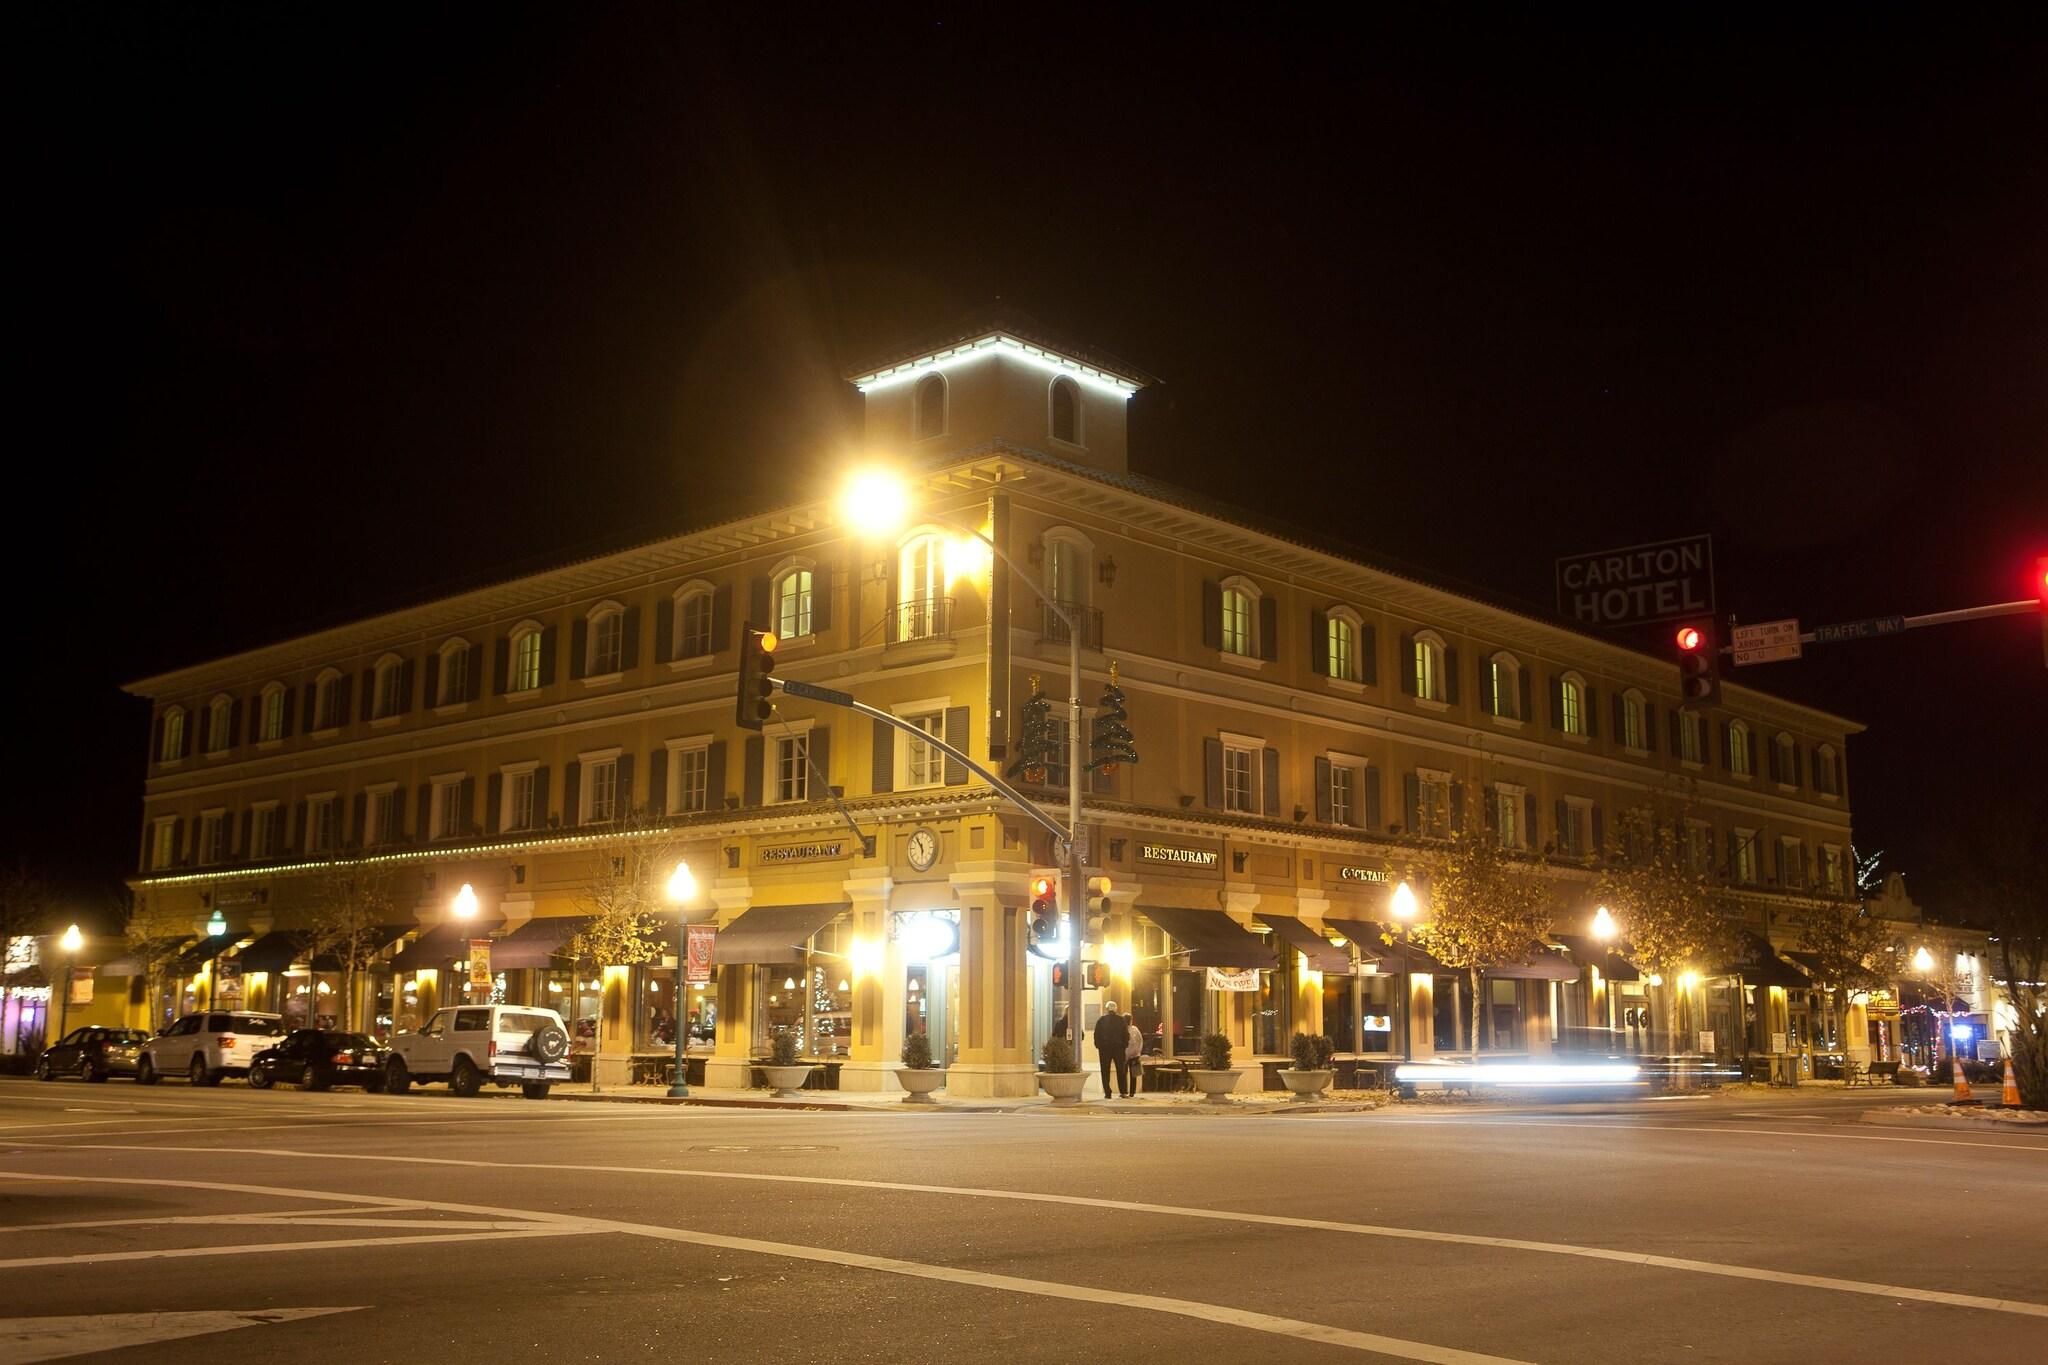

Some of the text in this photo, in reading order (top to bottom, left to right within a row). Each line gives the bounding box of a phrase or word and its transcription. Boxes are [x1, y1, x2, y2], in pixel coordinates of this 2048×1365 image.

[1563, 543, 1703, 589] CARLTON
[1574, 577, 1705, 624] HOTEL
[1736, 623, 1794, 639] LEFT TURN ON
[1818, 616, 1901, 641] TRAFFIC WAY
[1737, 638, 1765, 649] ARROW
[1736, 652, 1750, 662] NO
[1758, 650, 1765, 659] U
[762, 842, 844, 861] RESTAURANT
[1143, 846, 1217, 864] RESTAURANT
